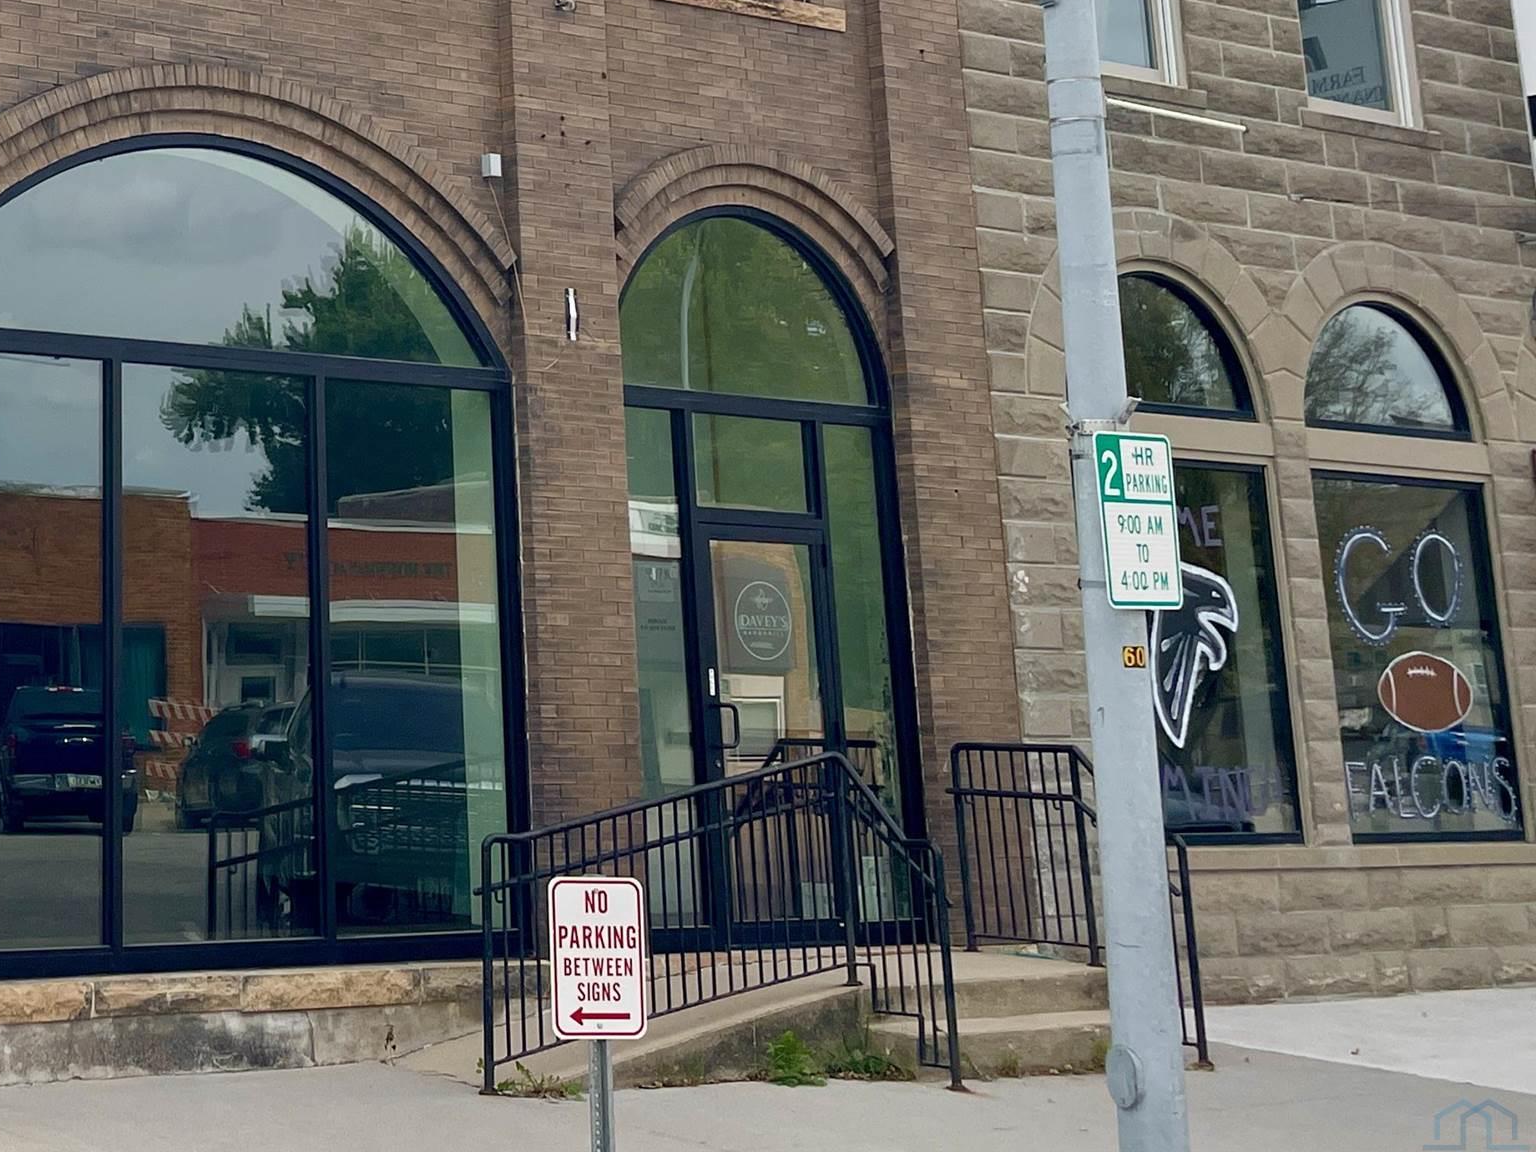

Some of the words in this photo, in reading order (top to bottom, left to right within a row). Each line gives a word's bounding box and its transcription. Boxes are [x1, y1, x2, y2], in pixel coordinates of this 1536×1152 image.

[1101, 450, 1121, 496] 2
[1132, 448, 1154, 466] HR
[1126, 473, 1167, 494] PARKING
[1117, 514, 1141, 535] 9:00
[1147, 515, 1163, 535] AM
[1136, 544, 1149, 563] TO
[1120, 571, 1149, 591] 4:00
[1153, 572, 1169, 591] PM
[1335, 525, 1464, 646] GO
[1124, 647, 1144, 667] 60
[1345, 755, 1518, 824] FALCONS
[585, 890, 608, 914] NO
[558, 925, 637, 949] PARKING
[564, 957, 633, 977] BETWEEN
[577, 982, 621, 1002] SIGNS
